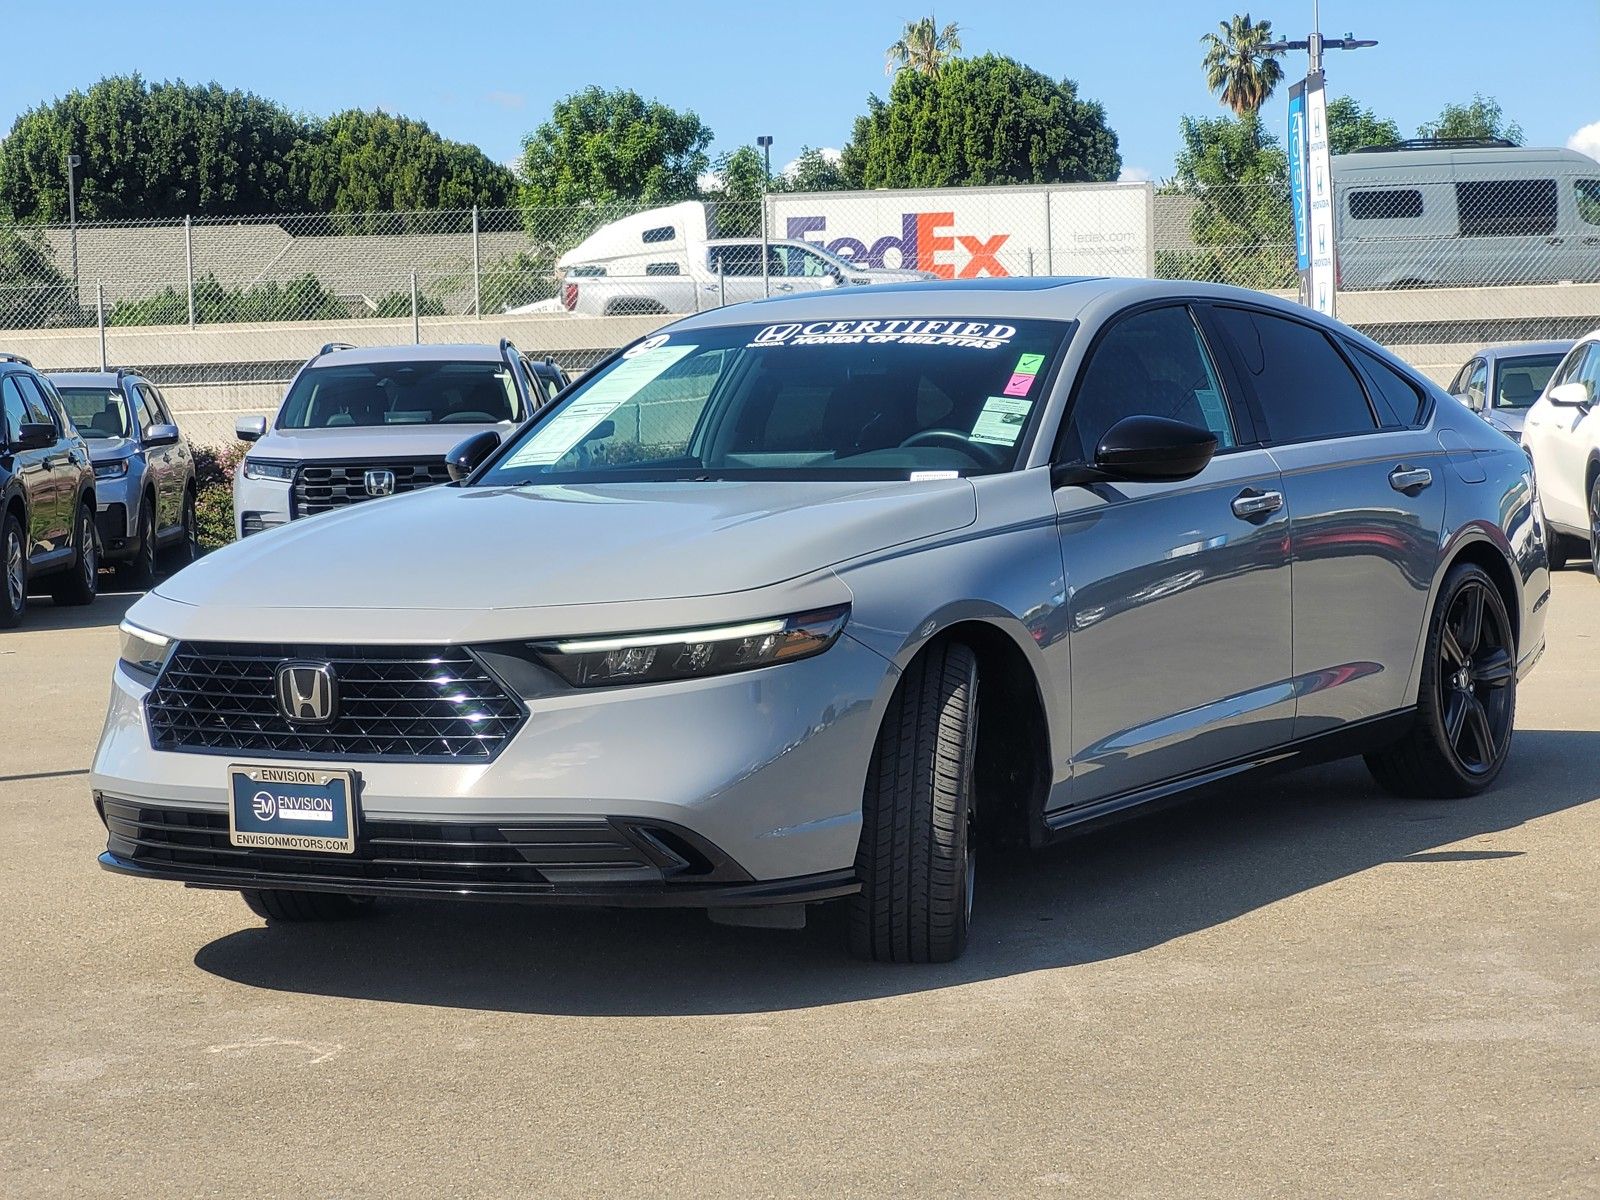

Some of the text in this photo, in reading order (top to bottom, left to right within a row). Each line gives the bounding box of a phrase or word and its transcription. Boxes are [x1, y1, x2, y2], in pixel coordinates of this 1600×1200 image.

[787, 211, 1011, 279] FedEx
[802, 320, 1016, 339] CERTIFIED
[790, 335, 1001, 349] HONDA OF MILPITAS
[261, 769, 315, 783] ENVISION
[278, 795, 333, 811] ENVISION
[236, 835, 349, 850] ENVISIONMOTORS.COM
